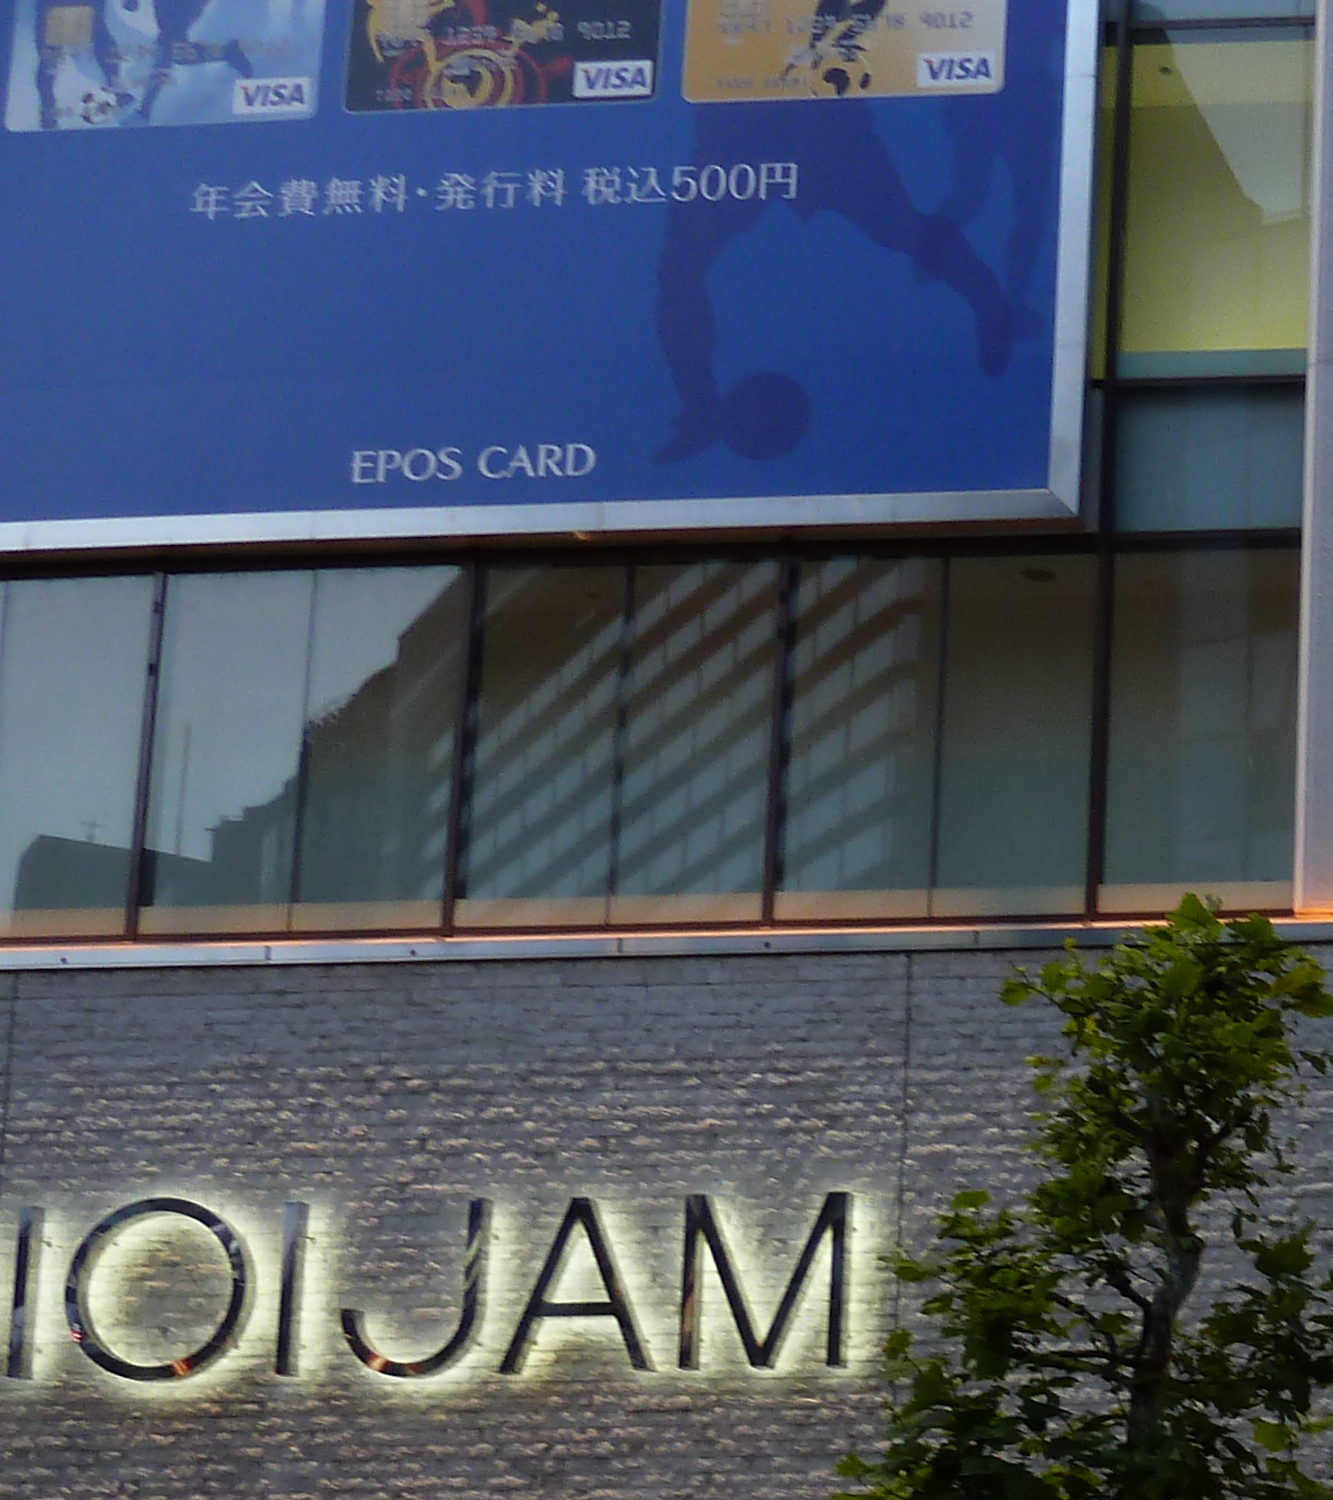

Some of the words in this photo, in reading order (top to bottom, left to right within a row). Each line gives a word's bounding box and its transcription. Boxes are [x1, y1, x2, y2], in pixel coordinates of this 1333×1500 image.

[582, 67, 648, 90] VISA
[924, 57, 991, 81] VISA
[239, 83, 306, 107] VISA
[582, 161, 799, 207] 税込500円
[351, 448, 462, 484] EPOS
[478, 442, 596, 481] CARD
